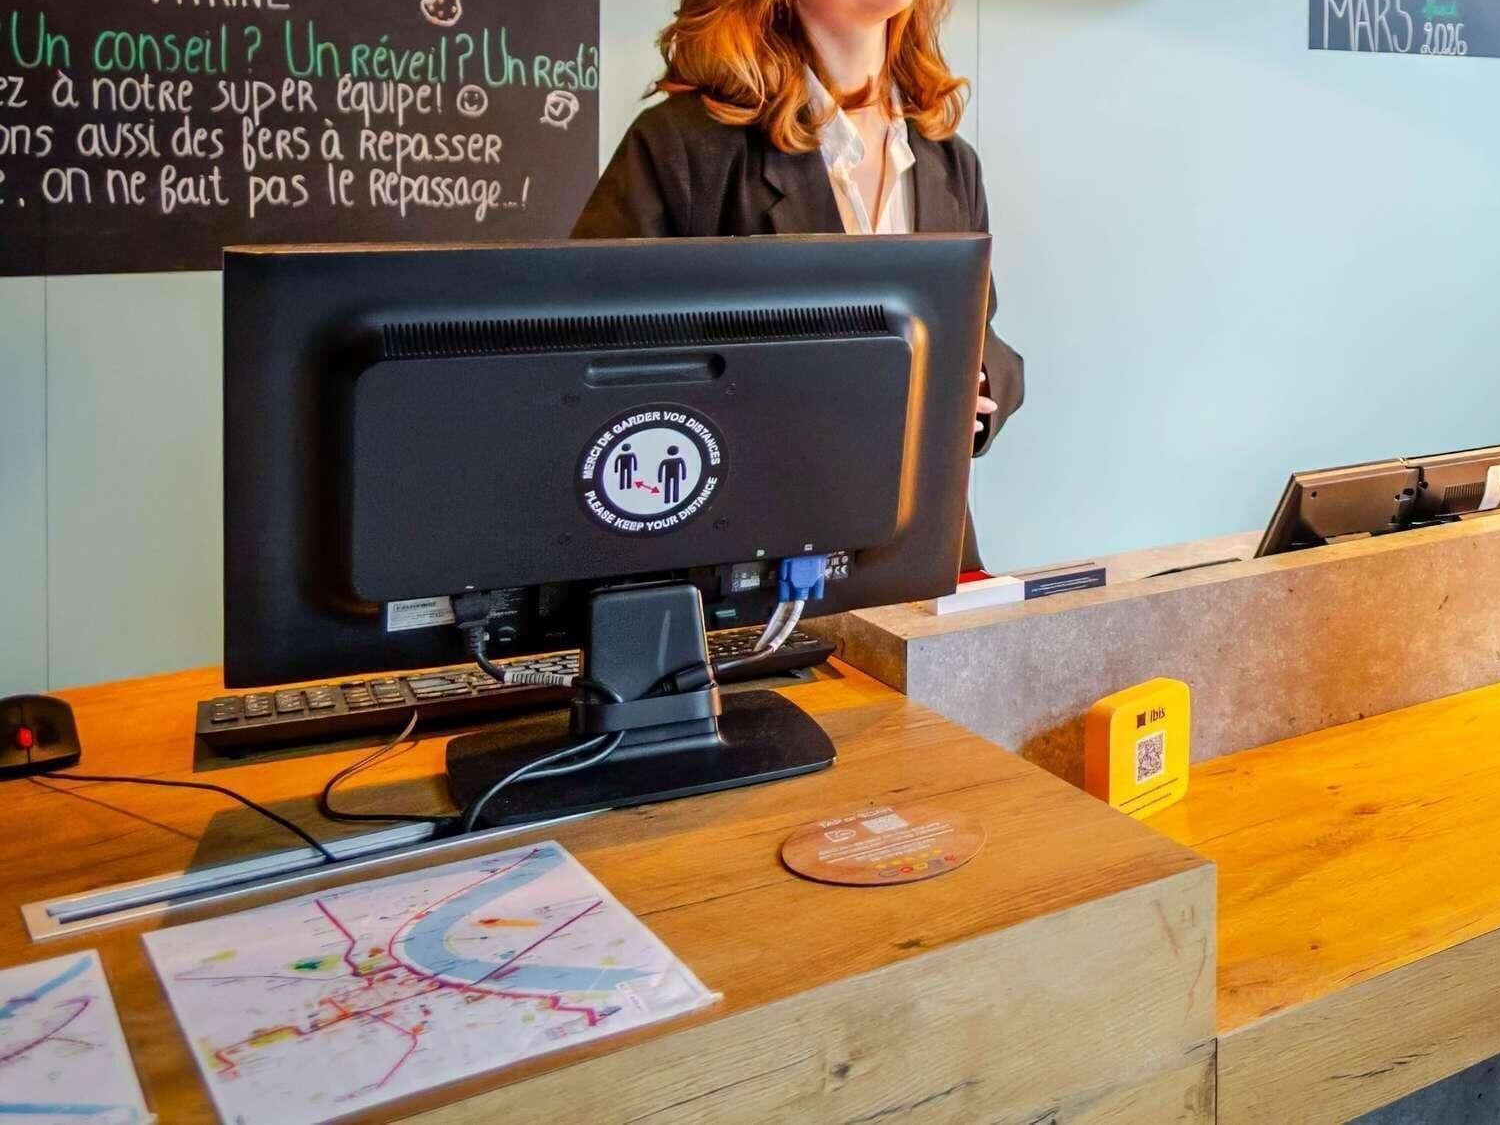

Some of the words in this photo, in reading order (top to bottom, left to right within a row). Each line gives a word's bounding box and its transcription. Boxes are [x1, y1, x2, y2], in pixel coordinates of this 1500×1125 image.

[11, 10, 71, 69] Un
[93, 22, 228, 74] conseil
[284, 18, 340, 78] Un
[483, 26, 527, 89] Un
[51, 69, 80, 109] à
[76, 118, 161, 159] aussi
[171, 114, 225, 160] des
[320, 117, 345, 161] à
[41, 166, 92, 204] on
[106, 168, 146, 205] ne
[249, 173, 311, 219] pas
[327, 161, 355, 207] le
